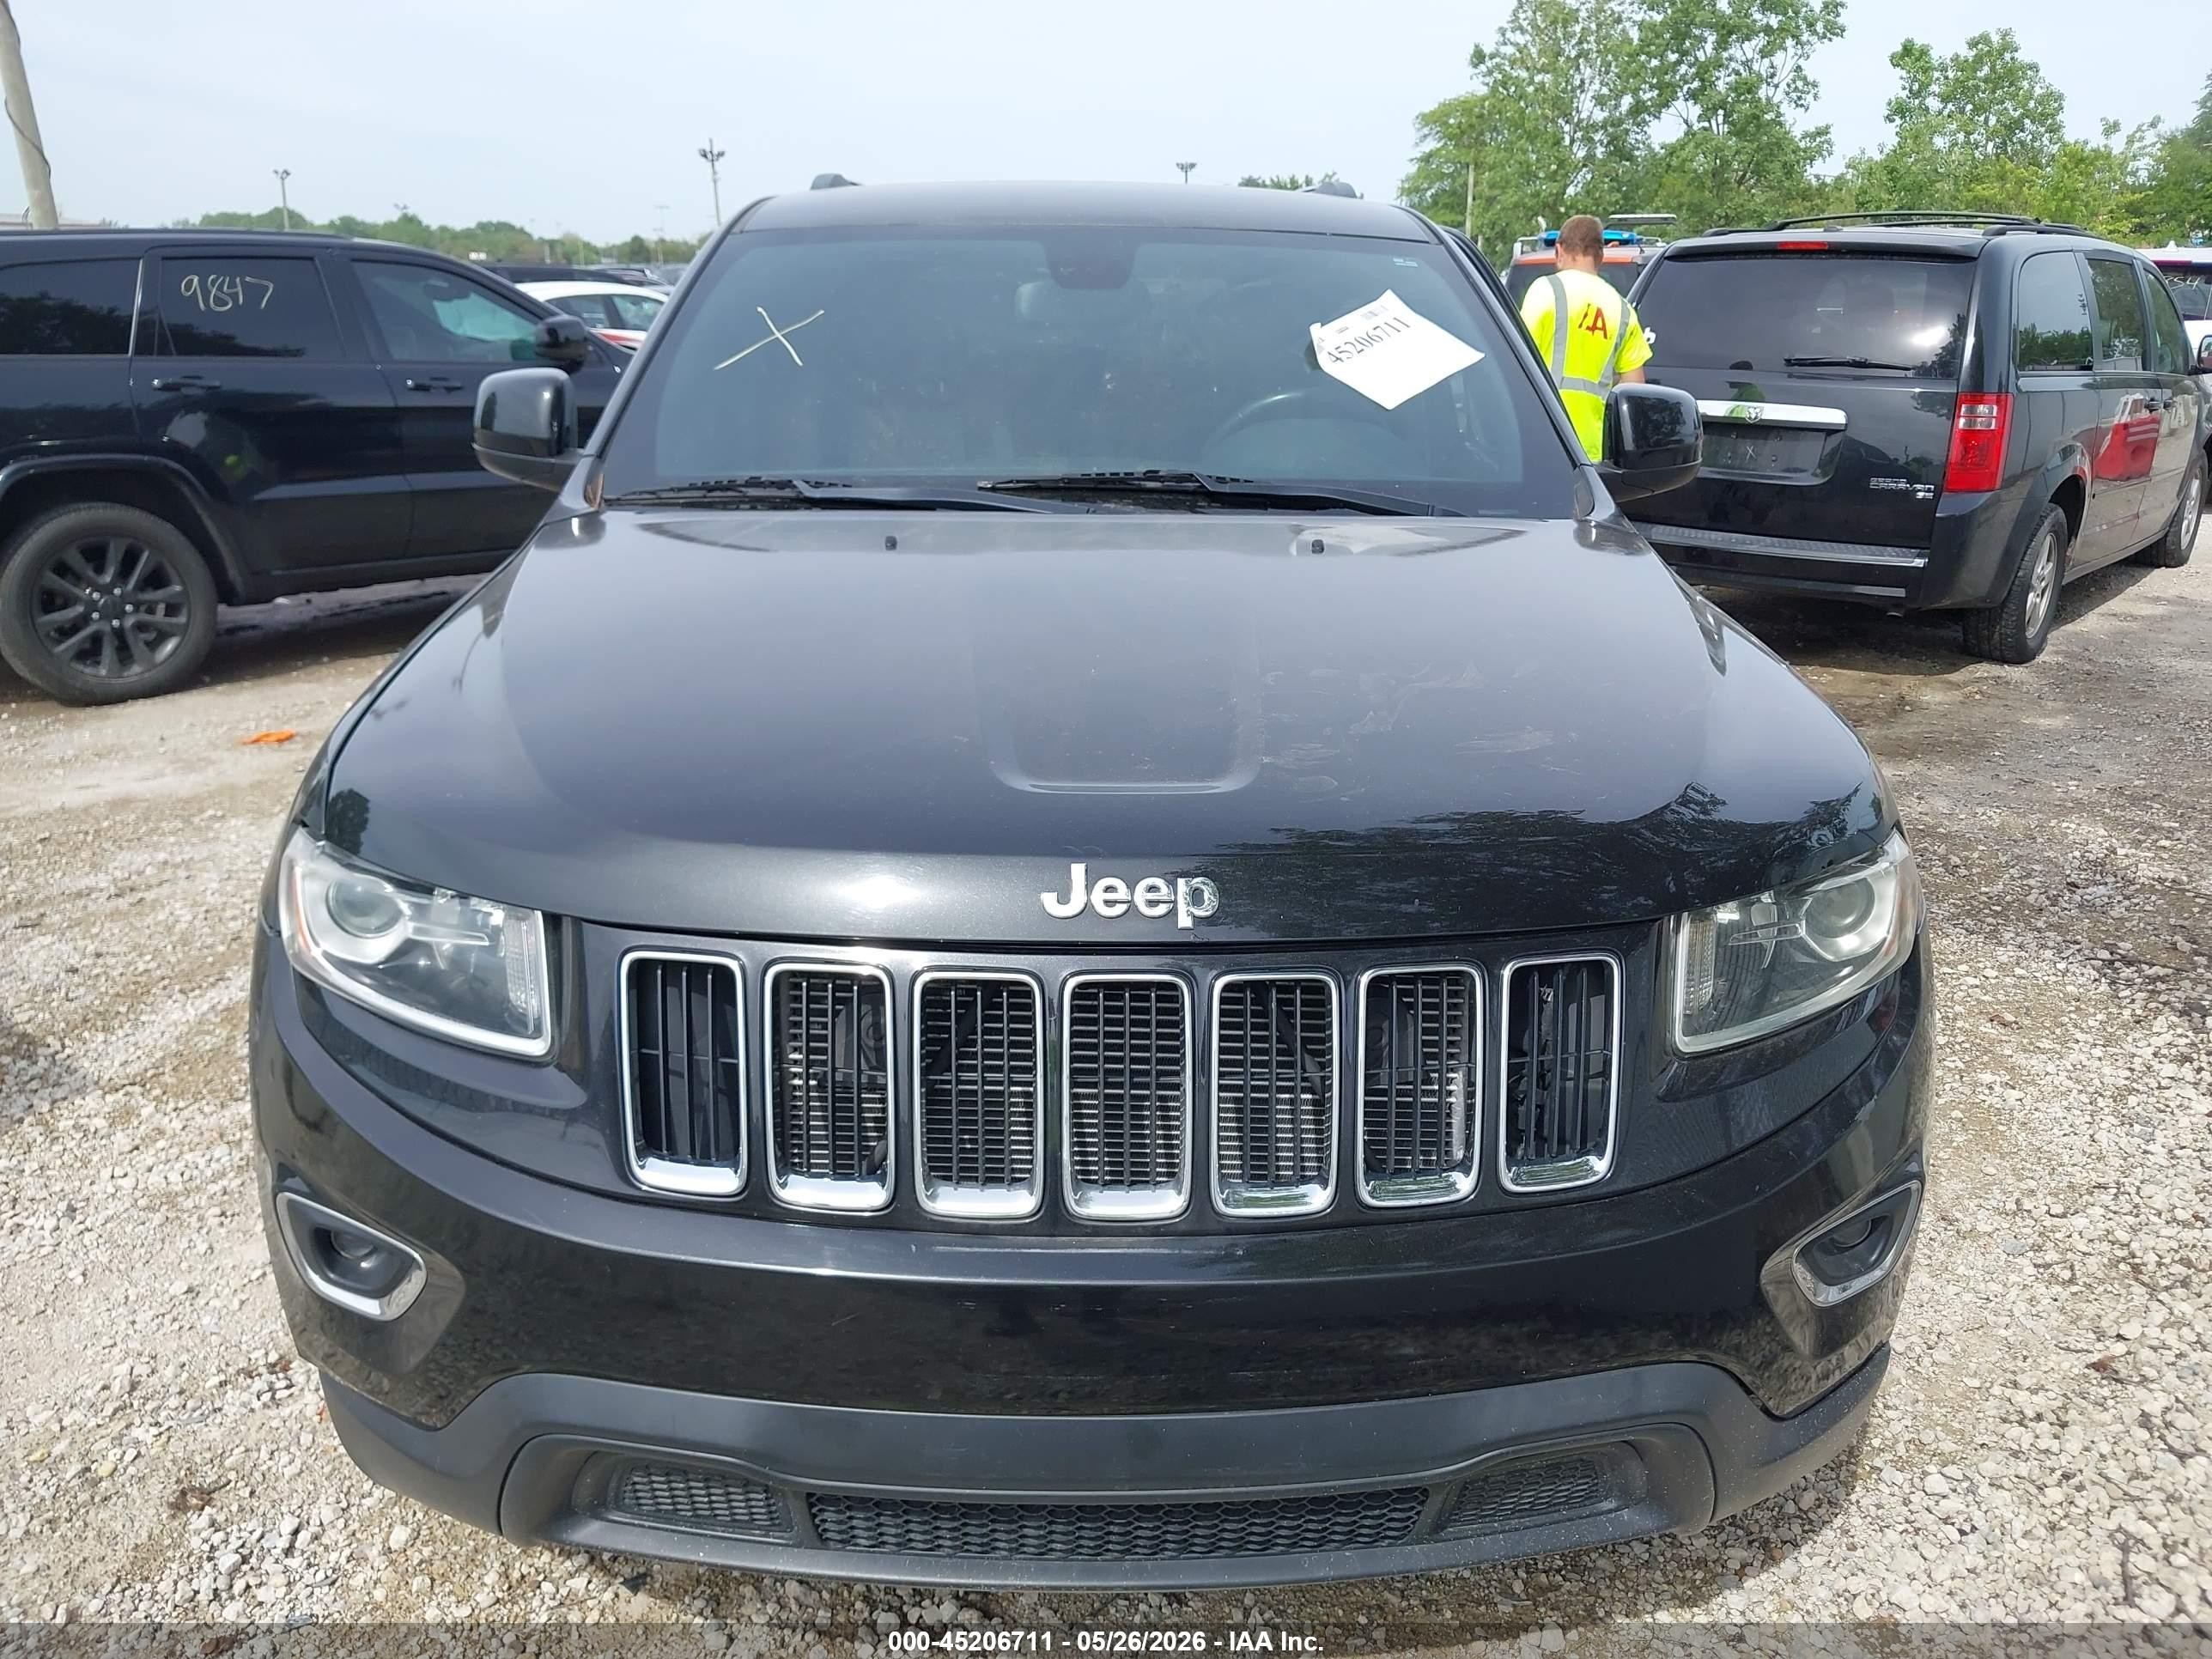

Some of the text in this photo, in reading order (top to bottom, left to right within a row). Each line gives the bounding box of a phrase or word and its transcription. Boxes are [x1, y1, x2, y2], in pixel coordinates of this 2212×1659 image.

[180, 274, 274, 312] 9847
[1327, 316, 1411, 363] 45206711
[1040, 862, 1219, 930] Jeep
